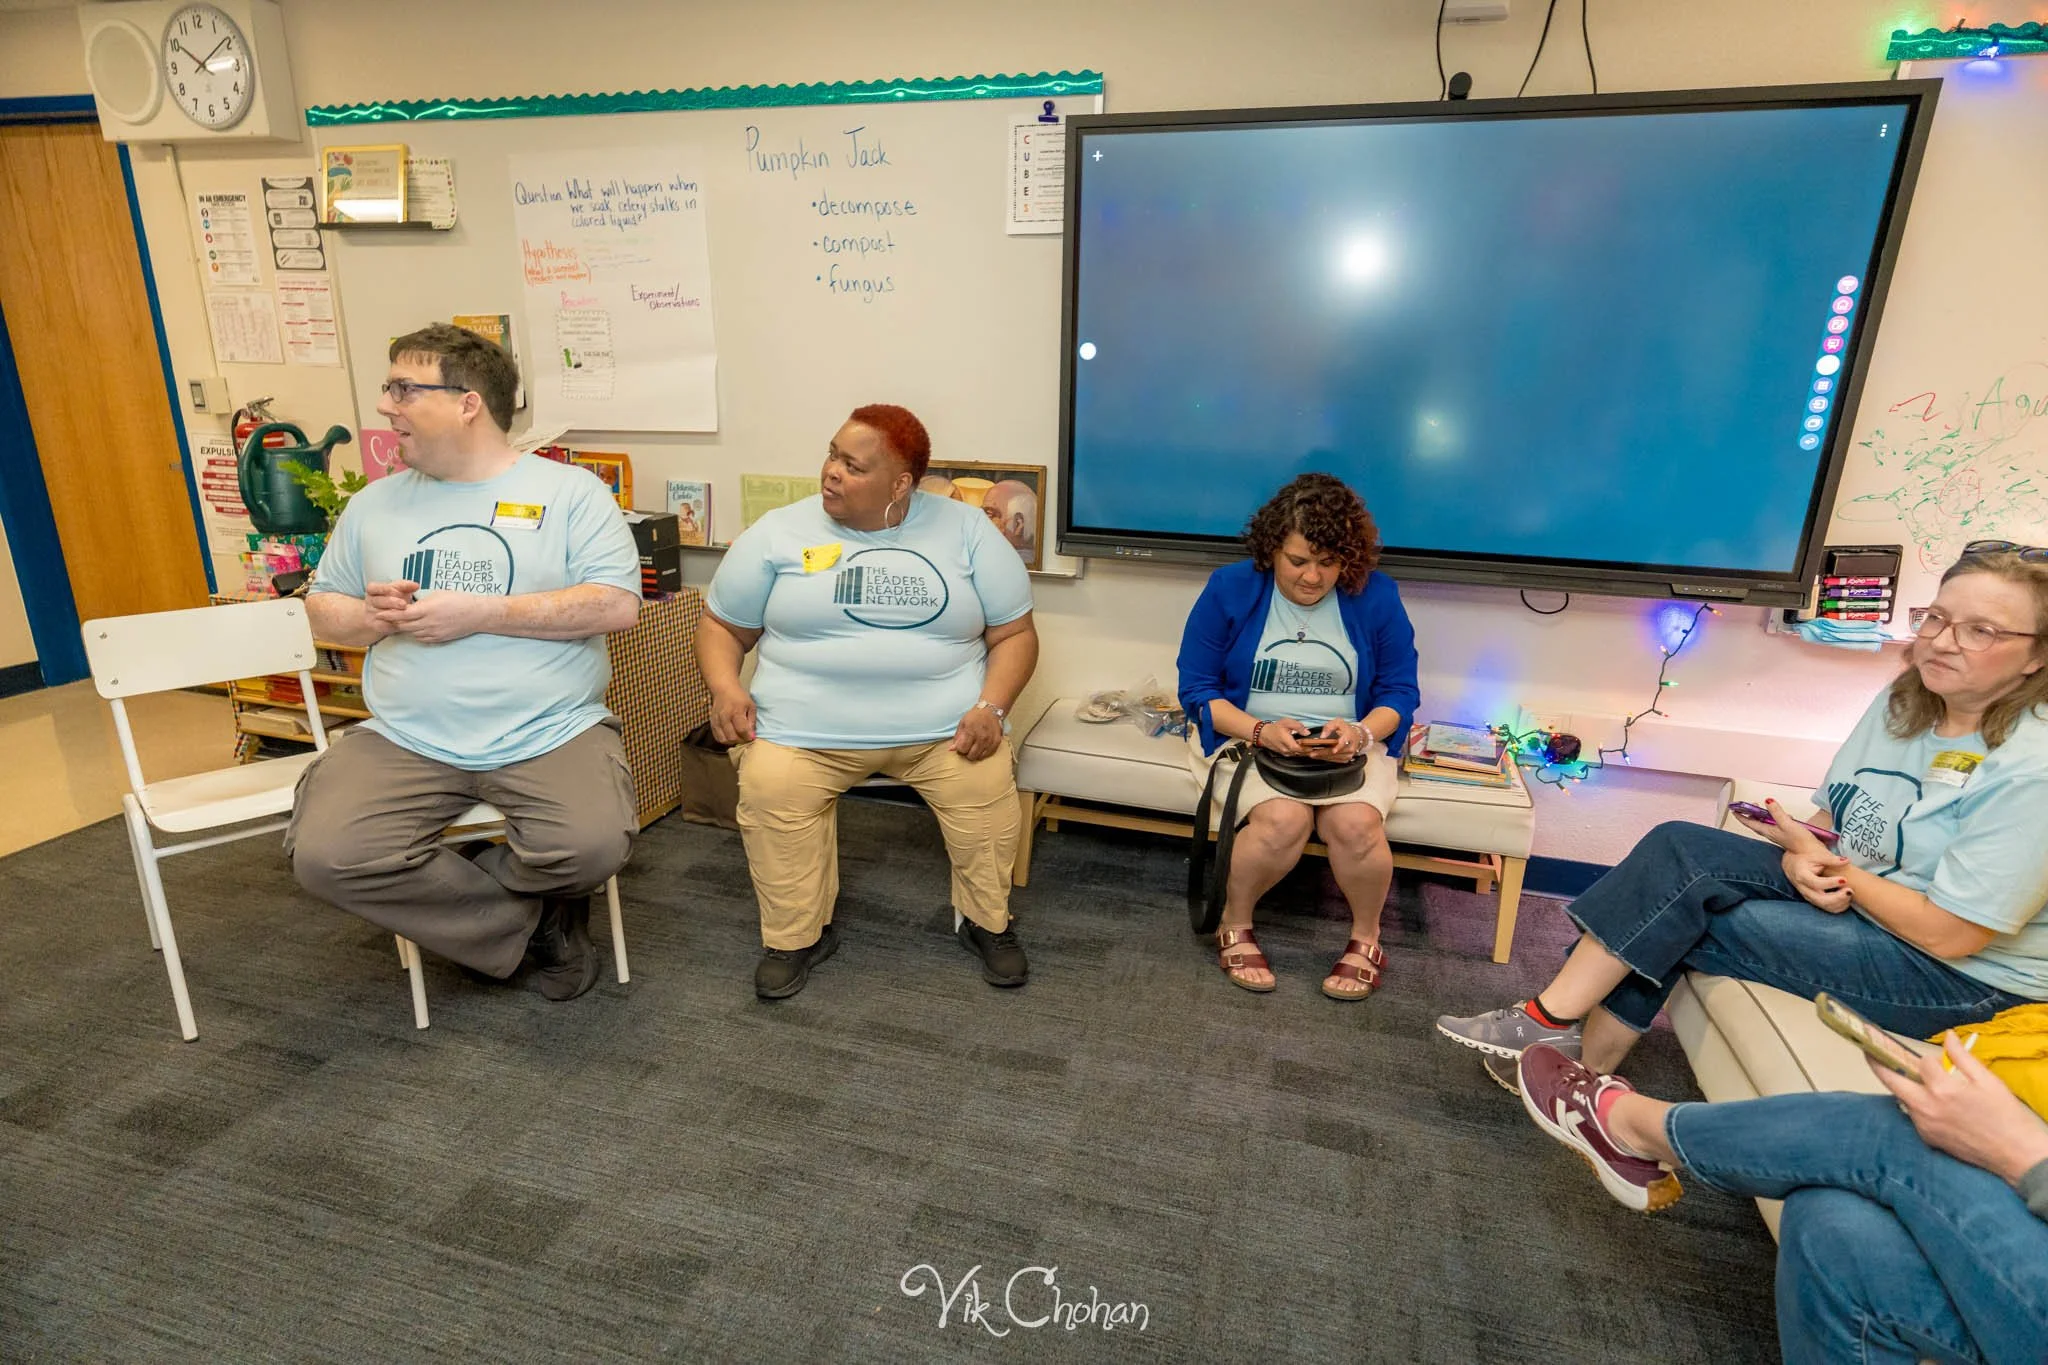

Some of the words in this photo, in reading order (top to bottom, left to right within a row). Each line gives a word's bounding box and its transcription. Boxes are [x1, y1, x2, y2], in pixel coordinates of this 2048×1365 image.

[179, 20, 188, 36] 11
[192, 14, 203, 29] 12
[212, 20, 217, 34] 1
[170, 38, 180, 53] 10
[171, 62, 178, 75] 9
[179, 82, 186, 96] 8
[233, 81, 239, 95] 4
[192, 98, 198, 111] 7
[223, 97, 230, 110] 5
[208, 104, 215, 117] 6
[745, 126, 831, 180] Pumpkin
[843, 126, 892, 169] Jack
[601, 179, 620, 197] will
[622, 177, 663, 199] happen
[669, 173, 698, 192] when
[650, 196, 680, 213] stalks
[685, 198, 697, 209] in
[818, 189, 918, 222] decompose
[823, 231, 897, 256] compost
[830, 264, 896, 304] fungus
[436, 550, 461, 559] THE
[437, 559, 493, 572] LEADERS
[866, 566, 887, 575] THE
[435, 570, 494, 582] READERS
[867, 575, 926, 586] LEADERS
[434, 580, 502, 594] NETWORK
[866, 585, 928, 597] READERS
[866, 595, 939, 608] NETWORK
[1280, 660, 1300, 669] THE
[1280, 669, 1334, 680] LEADERS
[1277, 677, 1332, 687] READERS
[1277, 686, 1338, 695] NETWORK
[1856, 789, 1885, 814] THE
